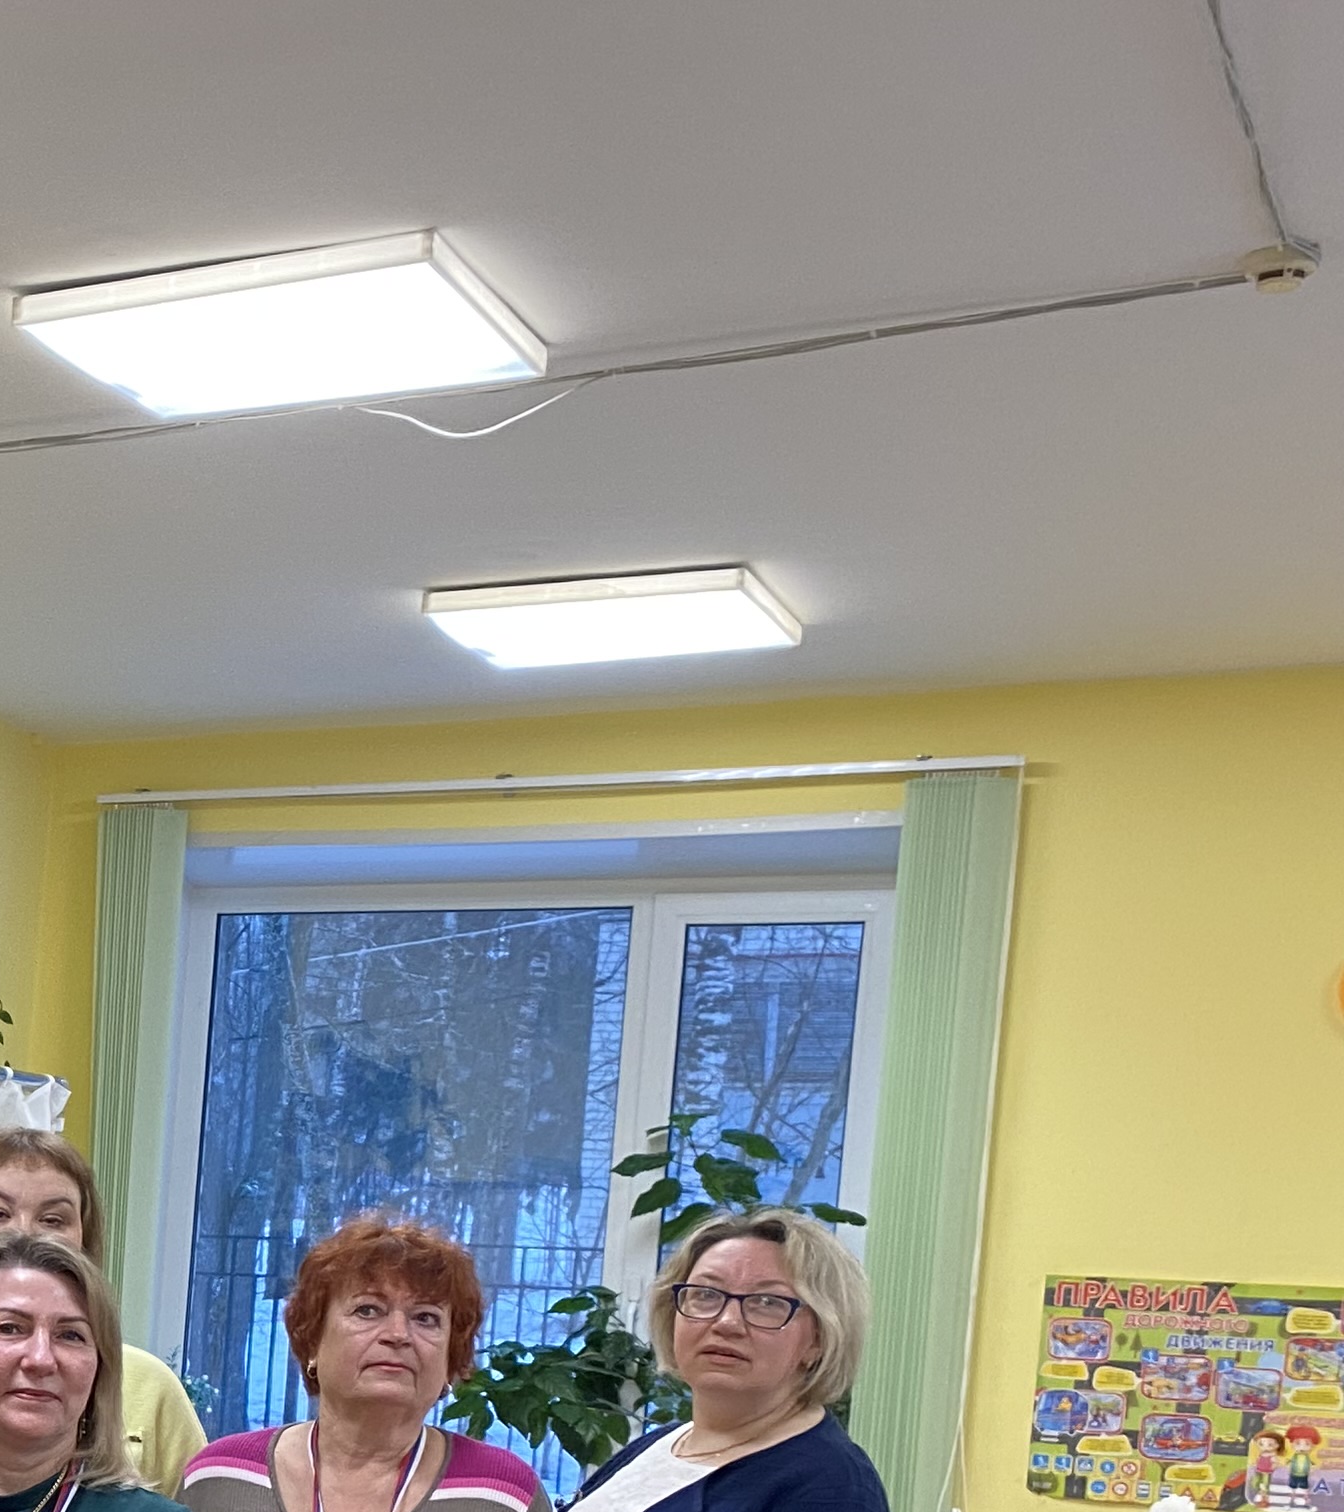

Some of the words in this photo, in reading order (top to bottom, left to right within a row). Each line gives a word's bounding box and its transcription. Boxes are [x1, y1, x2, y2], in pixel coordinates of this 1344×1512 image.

[1053, 1280, 1239, 1315] ПРАВИЛА
[1123, 1313, 1250, 1334] ДОРОЖНОГО
[1166, 1334, 1277, 1352] ДВИЖЕНИЯ
